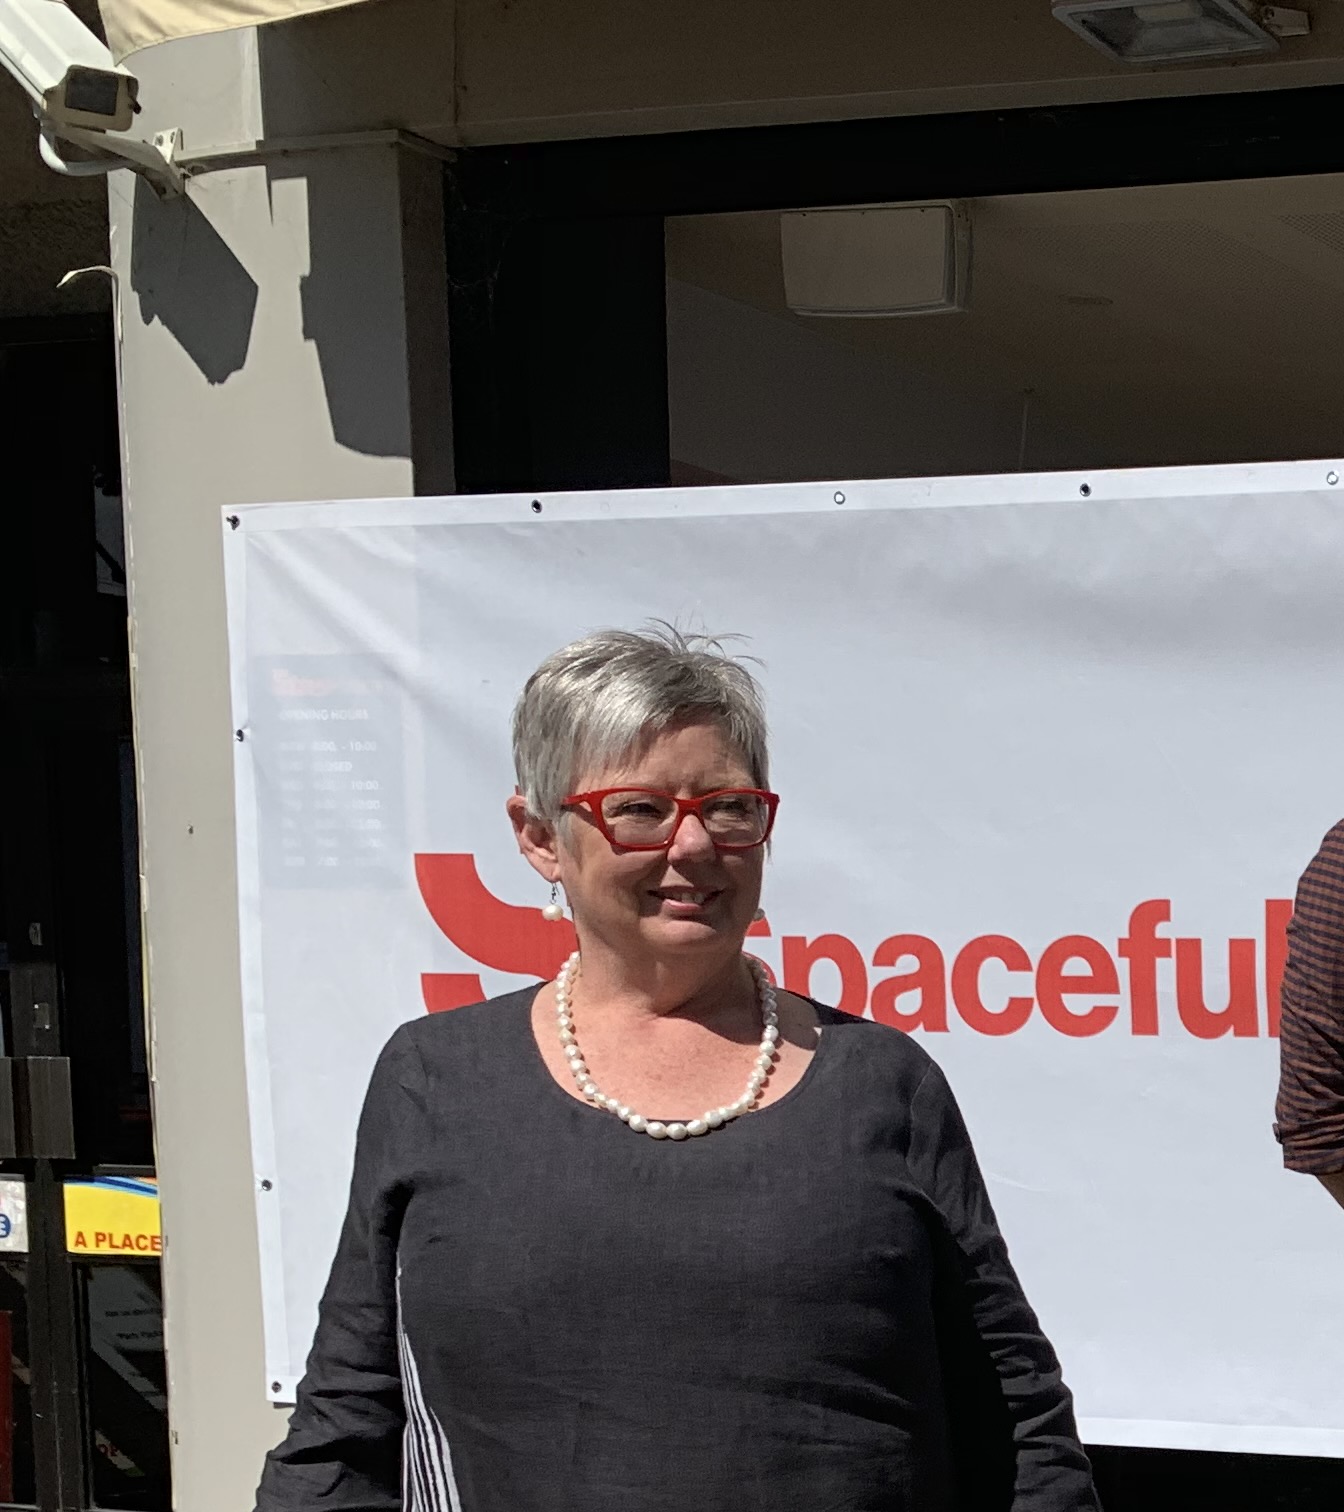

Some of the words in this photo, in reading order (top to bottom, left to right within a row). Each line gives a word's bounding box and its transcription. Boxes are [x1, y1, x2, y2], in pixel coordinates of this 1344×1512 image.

[745, 897, 1293, 1040] paceful
[74, 1231, 88, 1248] A
[94, 1231, 162, 1251] PLACE
